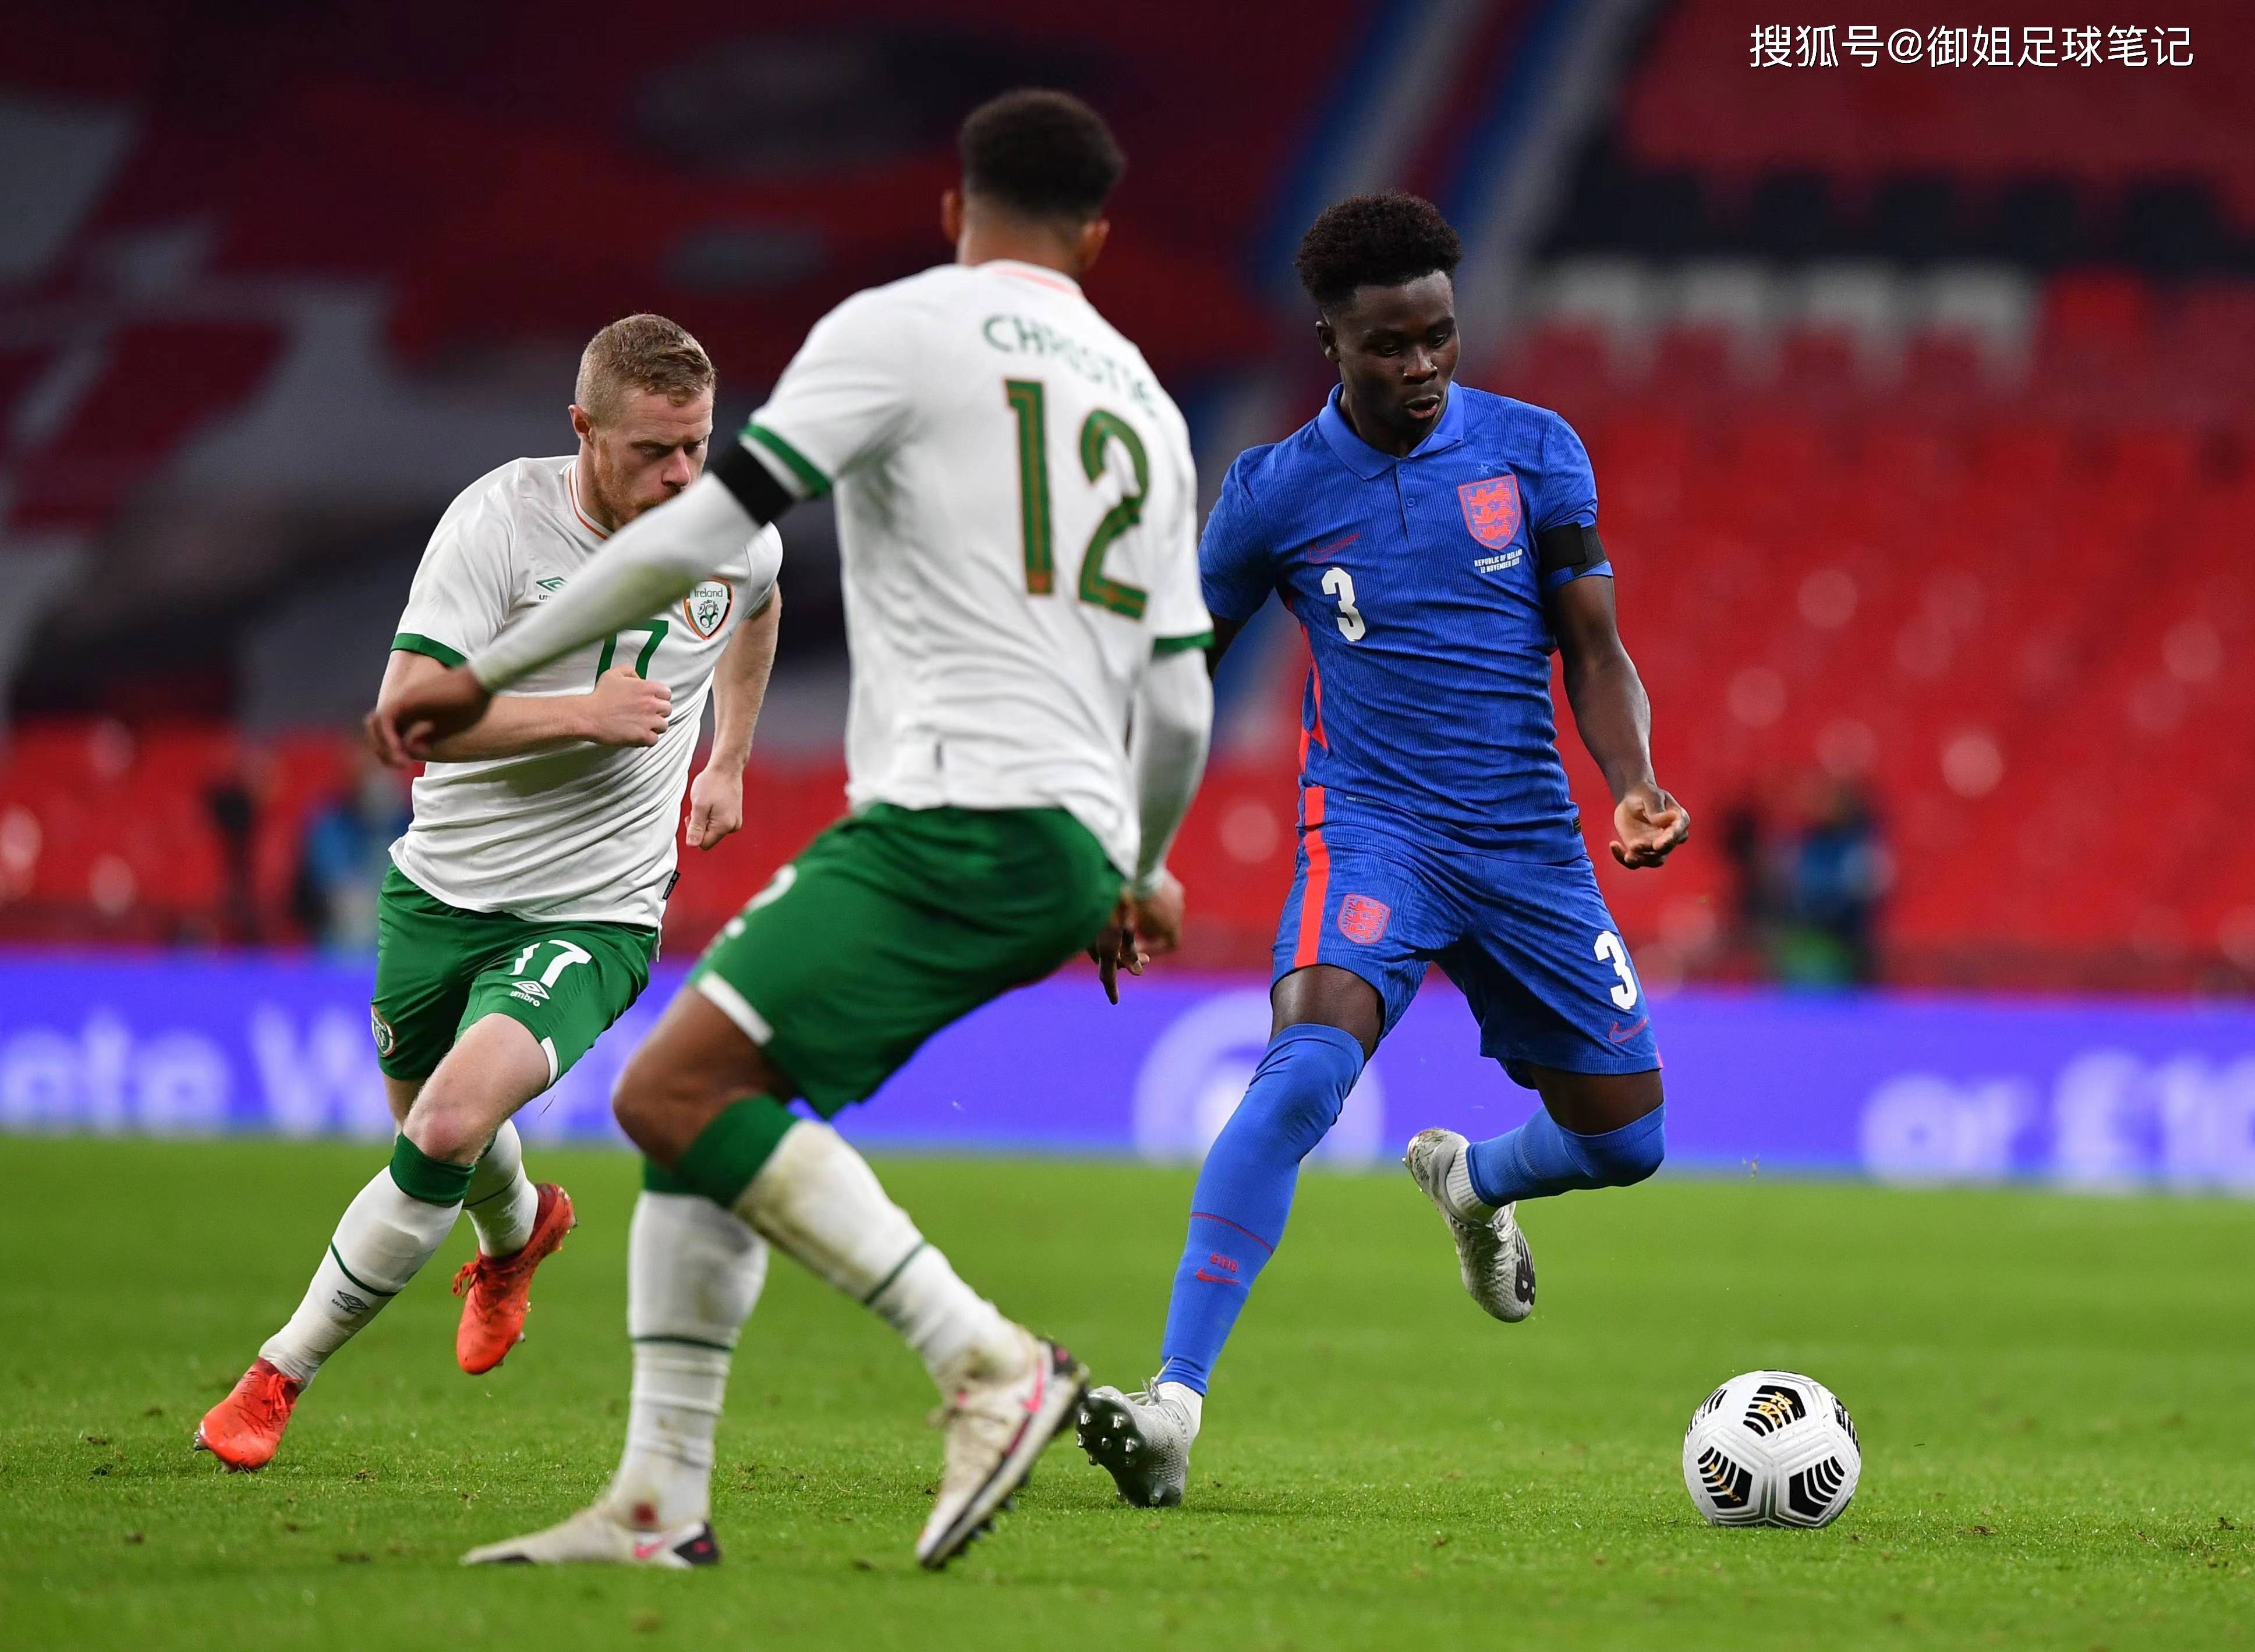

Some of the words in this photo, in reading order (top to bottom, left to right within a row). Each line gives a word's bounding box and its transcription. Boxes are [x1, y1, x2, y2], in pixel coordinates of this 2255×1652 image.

[1004, 378, 1149, 621] 12
[1474, 556, 1499, 566] REPUBLIC
[1486, 561, 1511, 572] NOVEMBER
[694, 587, 723, 597] Ireland
[1321, 567, 1365, 641] 3
[508, 940, 593, 988] 17
[1594, 930, 1637, 1010] 3
[509, 991, 540, 1007] umbro
